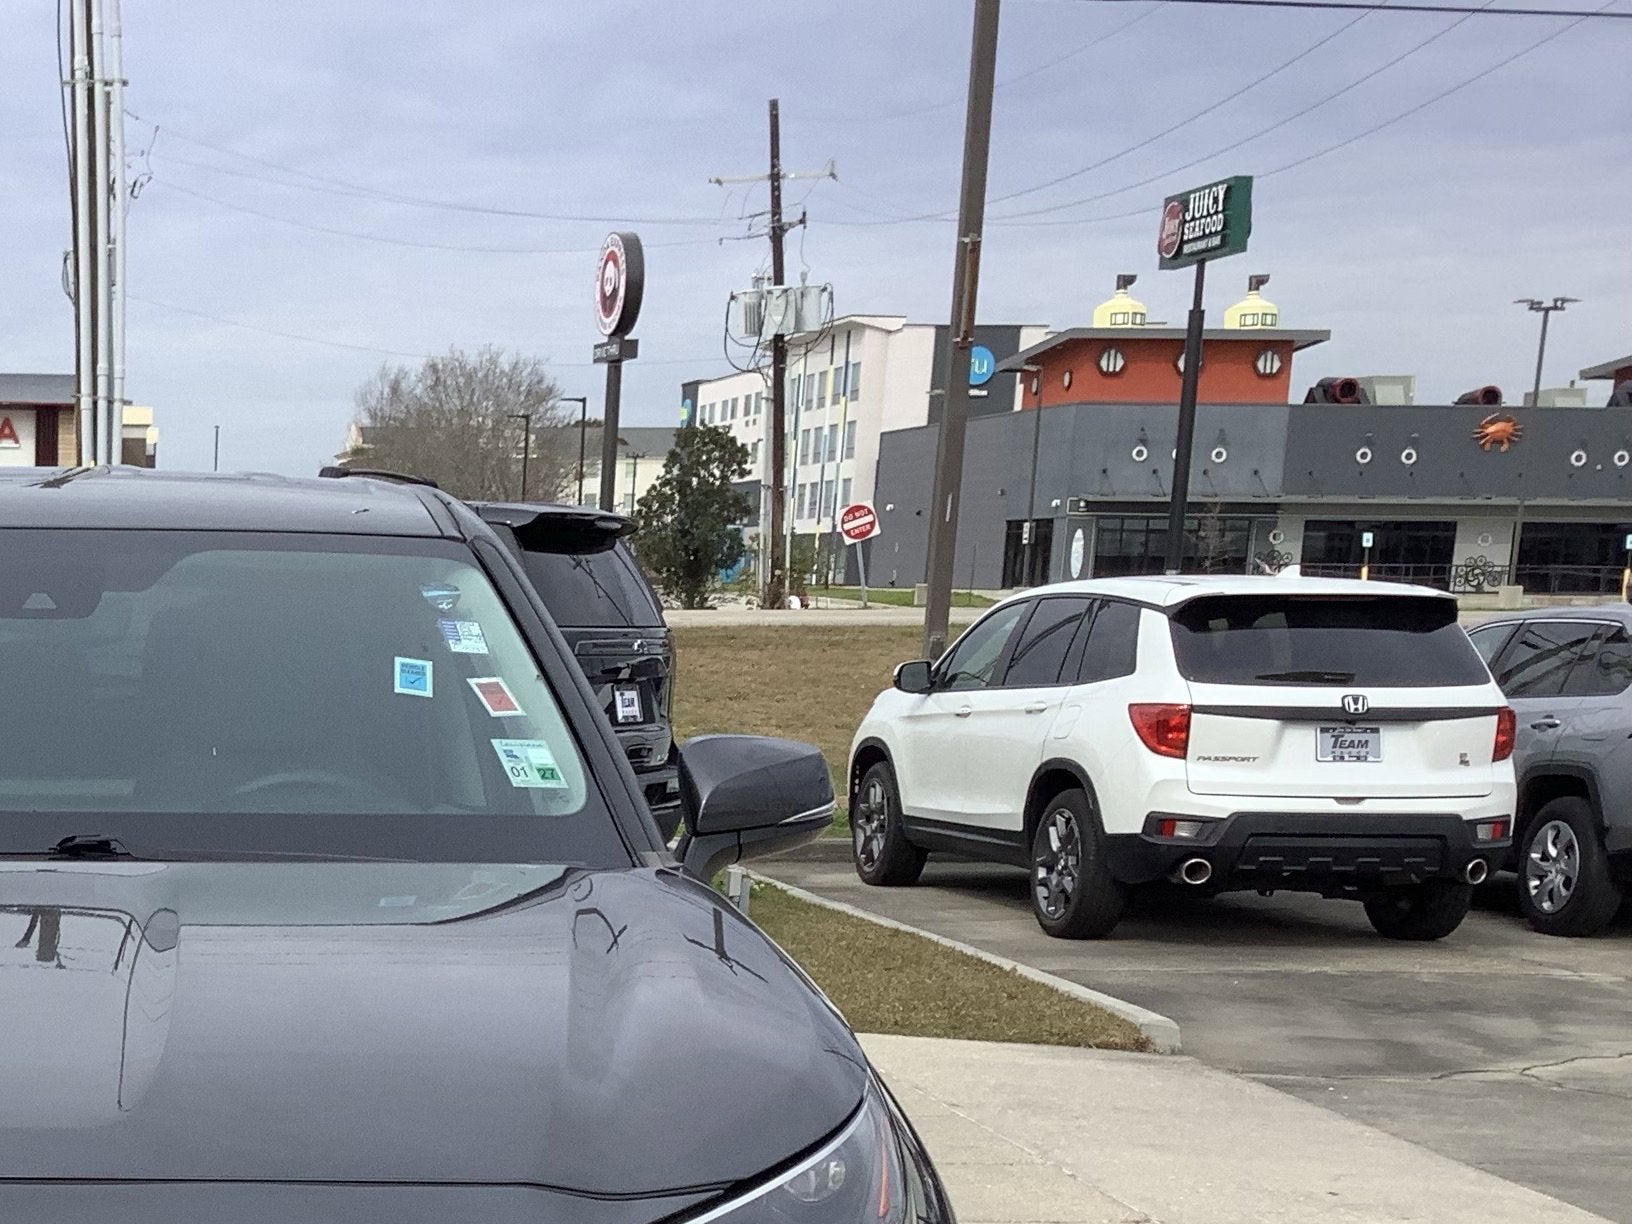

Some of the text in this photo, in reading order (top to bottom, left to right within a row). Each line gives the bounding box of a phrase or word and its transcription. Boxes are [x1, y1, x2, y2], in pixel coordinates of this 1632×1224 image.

[1184, 183, 1228, 221] JUICY
[1183, 213, 1225, 241] SEAFOOD
[1330, 734, 1369, 749] TEAM
[510, 766, 556, 780] 01 27
